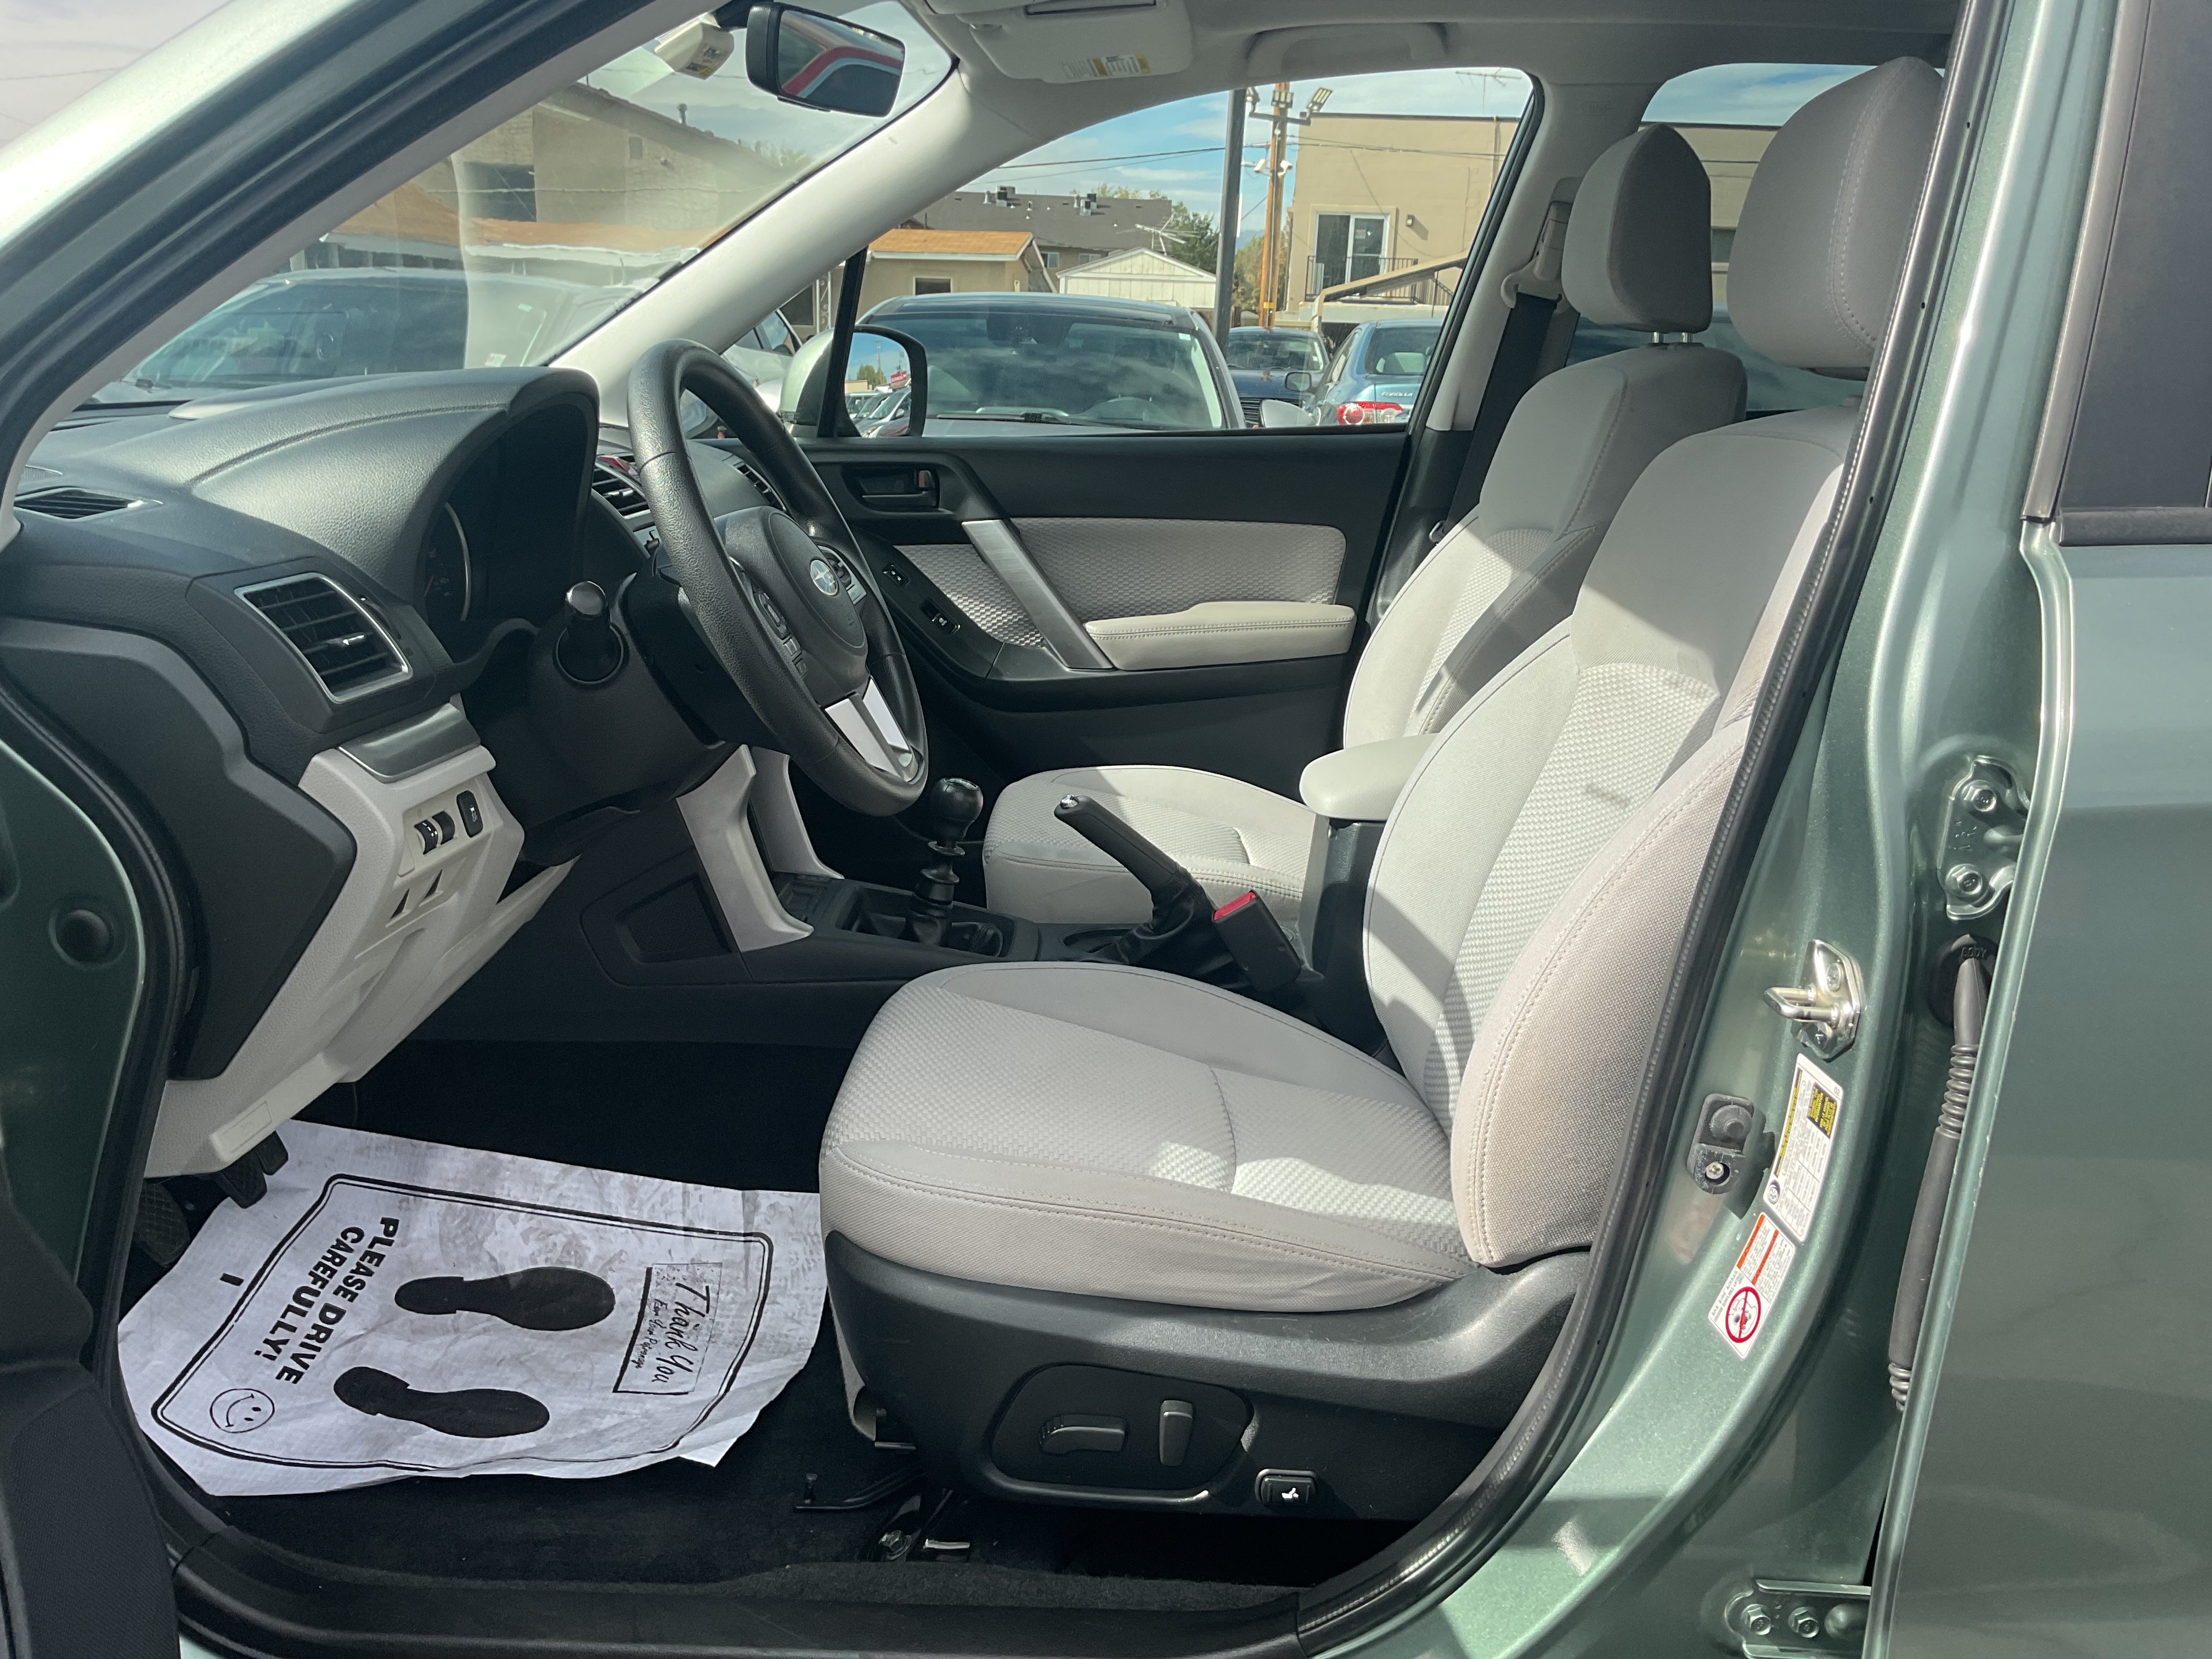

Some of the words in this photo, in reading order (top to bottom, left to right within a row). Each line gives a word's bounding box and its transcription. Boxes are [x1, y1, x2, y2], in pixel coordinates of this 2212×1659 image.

[254, 1227, 365, 1361] CAREFULLY!
[332, 1217, 399, 1302] PLEASE
[1726, 1270, 1738, 1290] AIRBAG
[275, 1302, 347, 1384] DRIVE
[664, 1282, 710, 1351] Thank
[652, 1355, 694, 1383] You
